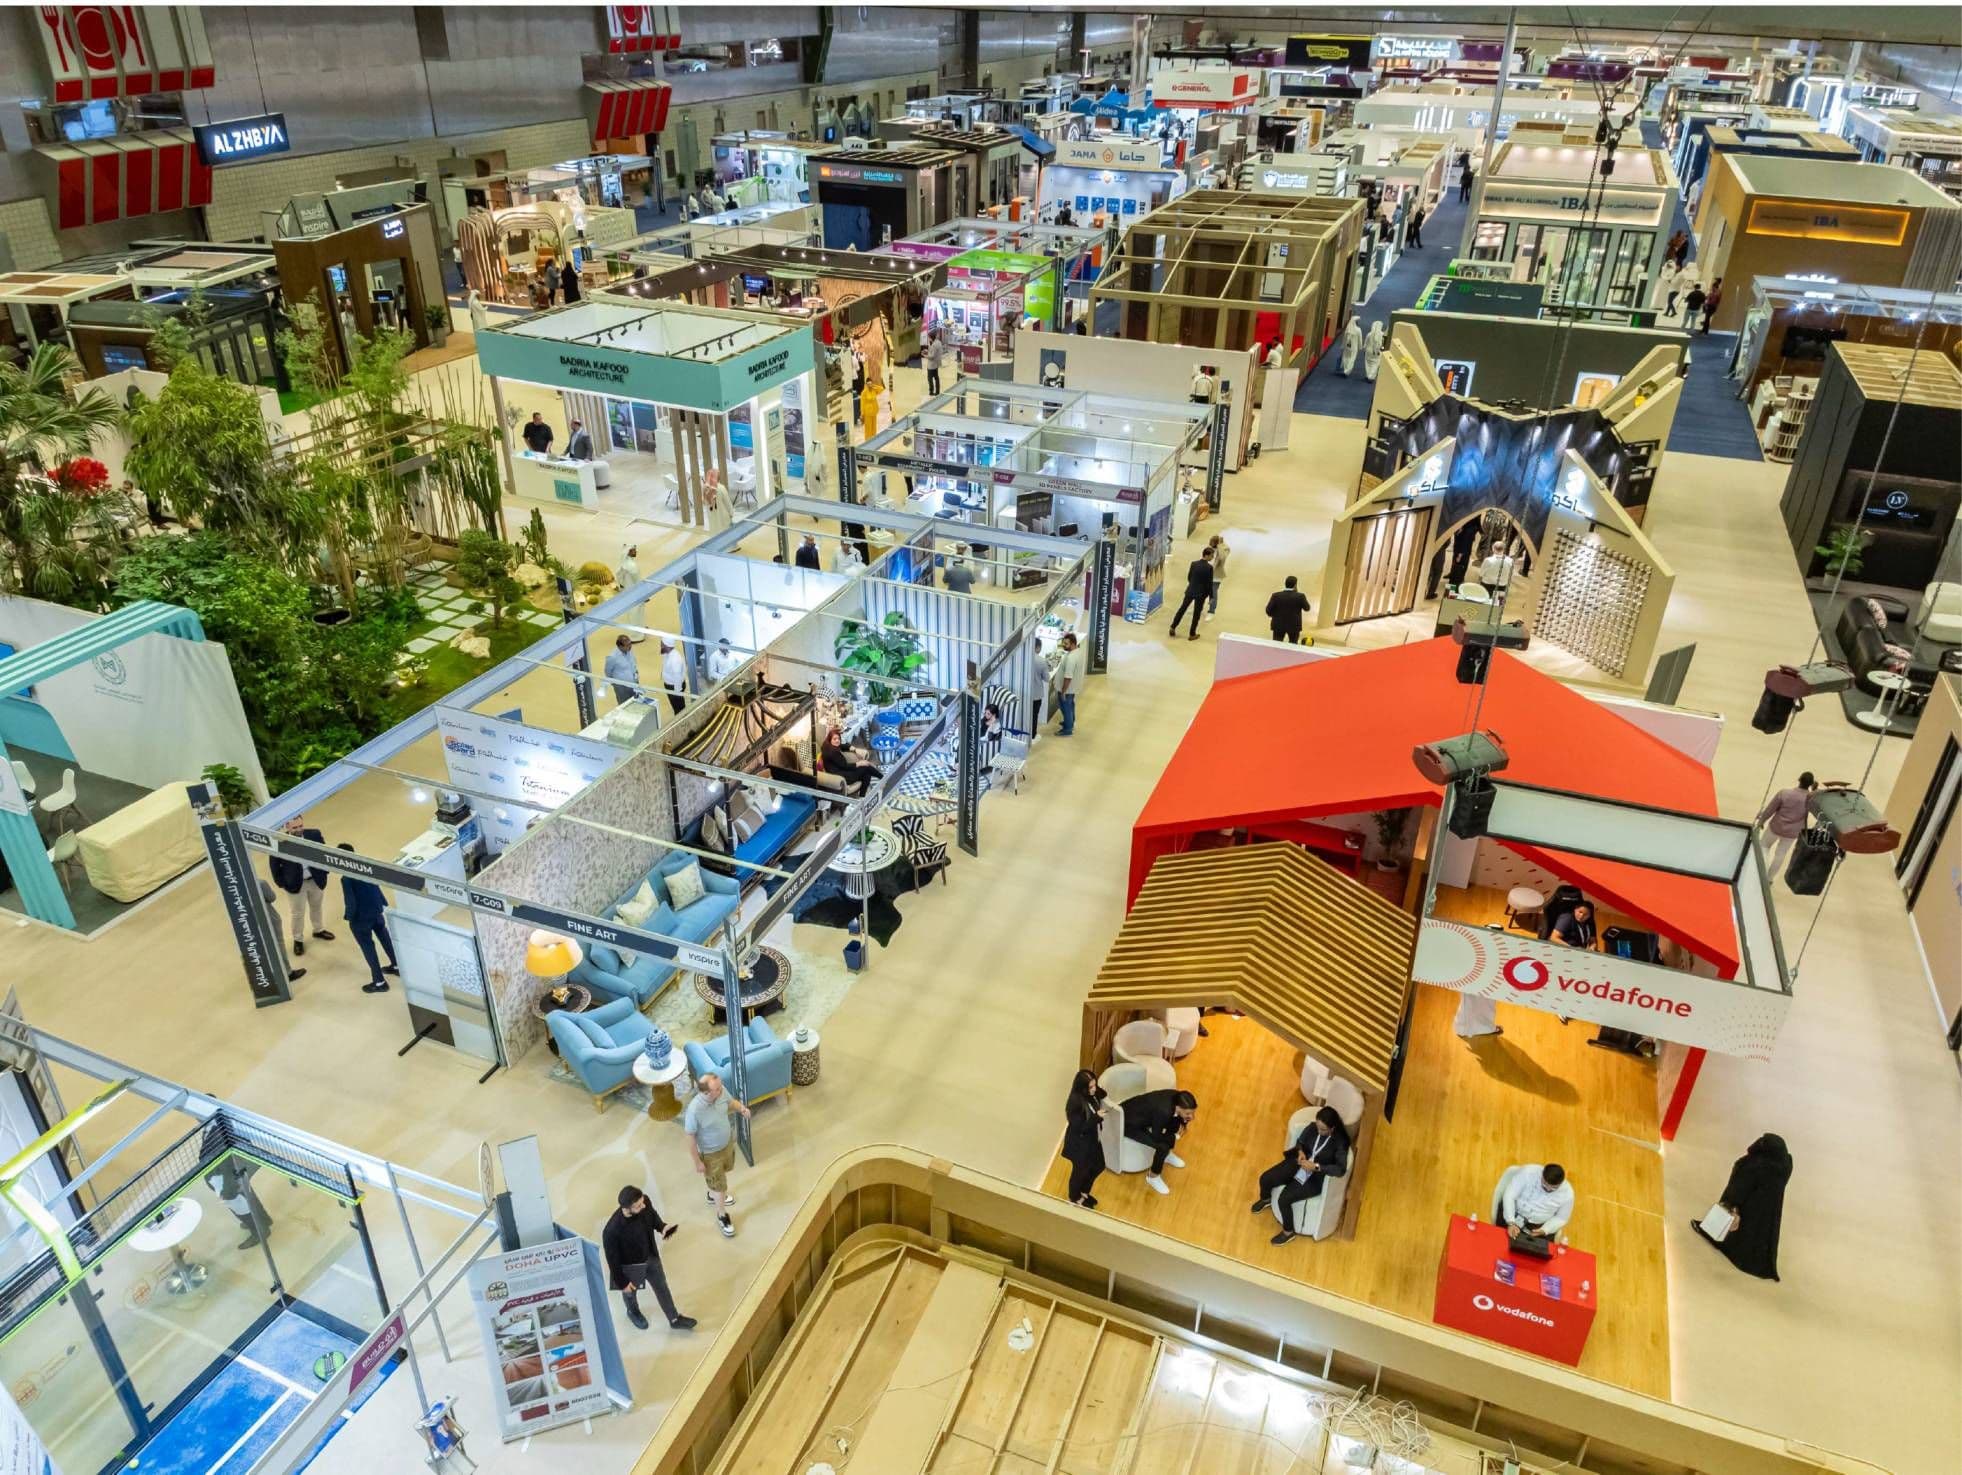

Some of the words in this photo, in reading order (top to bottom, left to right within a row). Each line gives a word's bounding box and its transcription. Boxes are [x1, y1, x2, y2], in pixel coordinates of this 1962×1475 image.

[1560, 196, 1590, 211] IBA
[1814, 216, 1838, 227] IBA
[560, 355, 591, 369] BADRIA
[593, 361, 629, 374] KAFOOD
[569, 367, 624, 384] ARCHITECTURE
[748, 360, 768, 376] BADRIA
[768, 350, 789, 366] KAFOOD
[211, 829, 229, 858] معرض
[323, 854, 373, 876] TITANIUM
[434, 882, 467, 897] inspire
[779, 880, 801, 904] FINE
[795, 865, 815, 886] ART
[226, 883, 248, 915] للديكور
[235, 911, 256, 943] والهدايا
[473, 894, 503, 910] 7-G09
[567, 920, 593, 936] FINE
[595, 927, 617, 943] ART
[688, 952, 721, 968] inspire
[1557, 975, 1692, 1017] vodafone
[505, 1258, 542, 1272] DOHA
[544, 1250, 579, 1263] UPVC
[1496, 1303, 1555, 1328] vodafone
